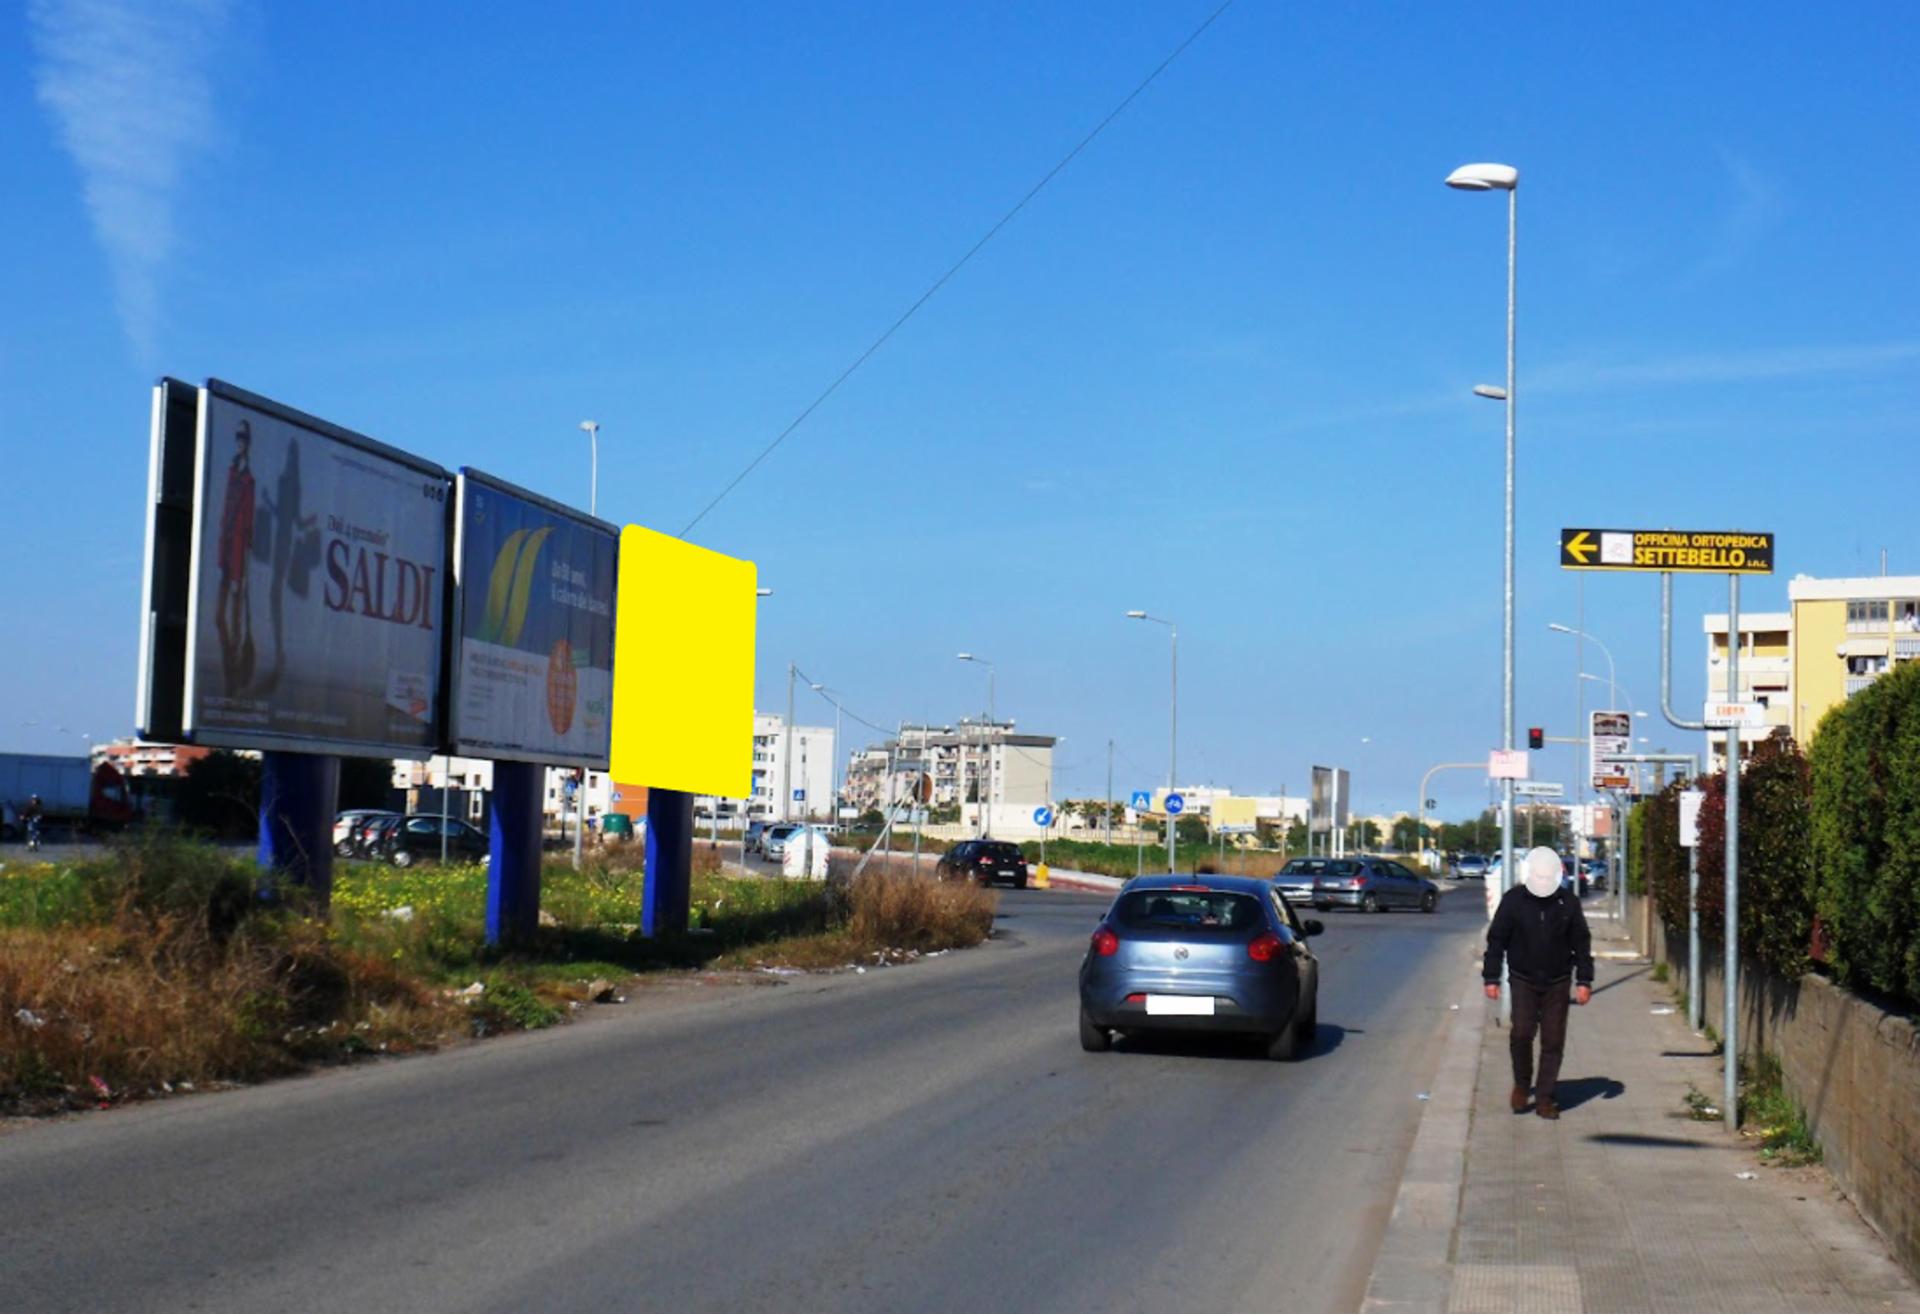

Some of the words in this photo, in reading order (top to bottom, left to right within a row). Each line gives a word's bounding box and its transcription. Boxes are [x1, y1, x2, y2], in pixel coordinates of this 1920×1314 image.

[1634, 533, 1689, 546] OFFICINA
[1692, 535, 1768, 548] ORTOPEDICA
[1634, 548, 1746, 567] SETTEBELLO
[324, 538, 436, 631] SALDI
